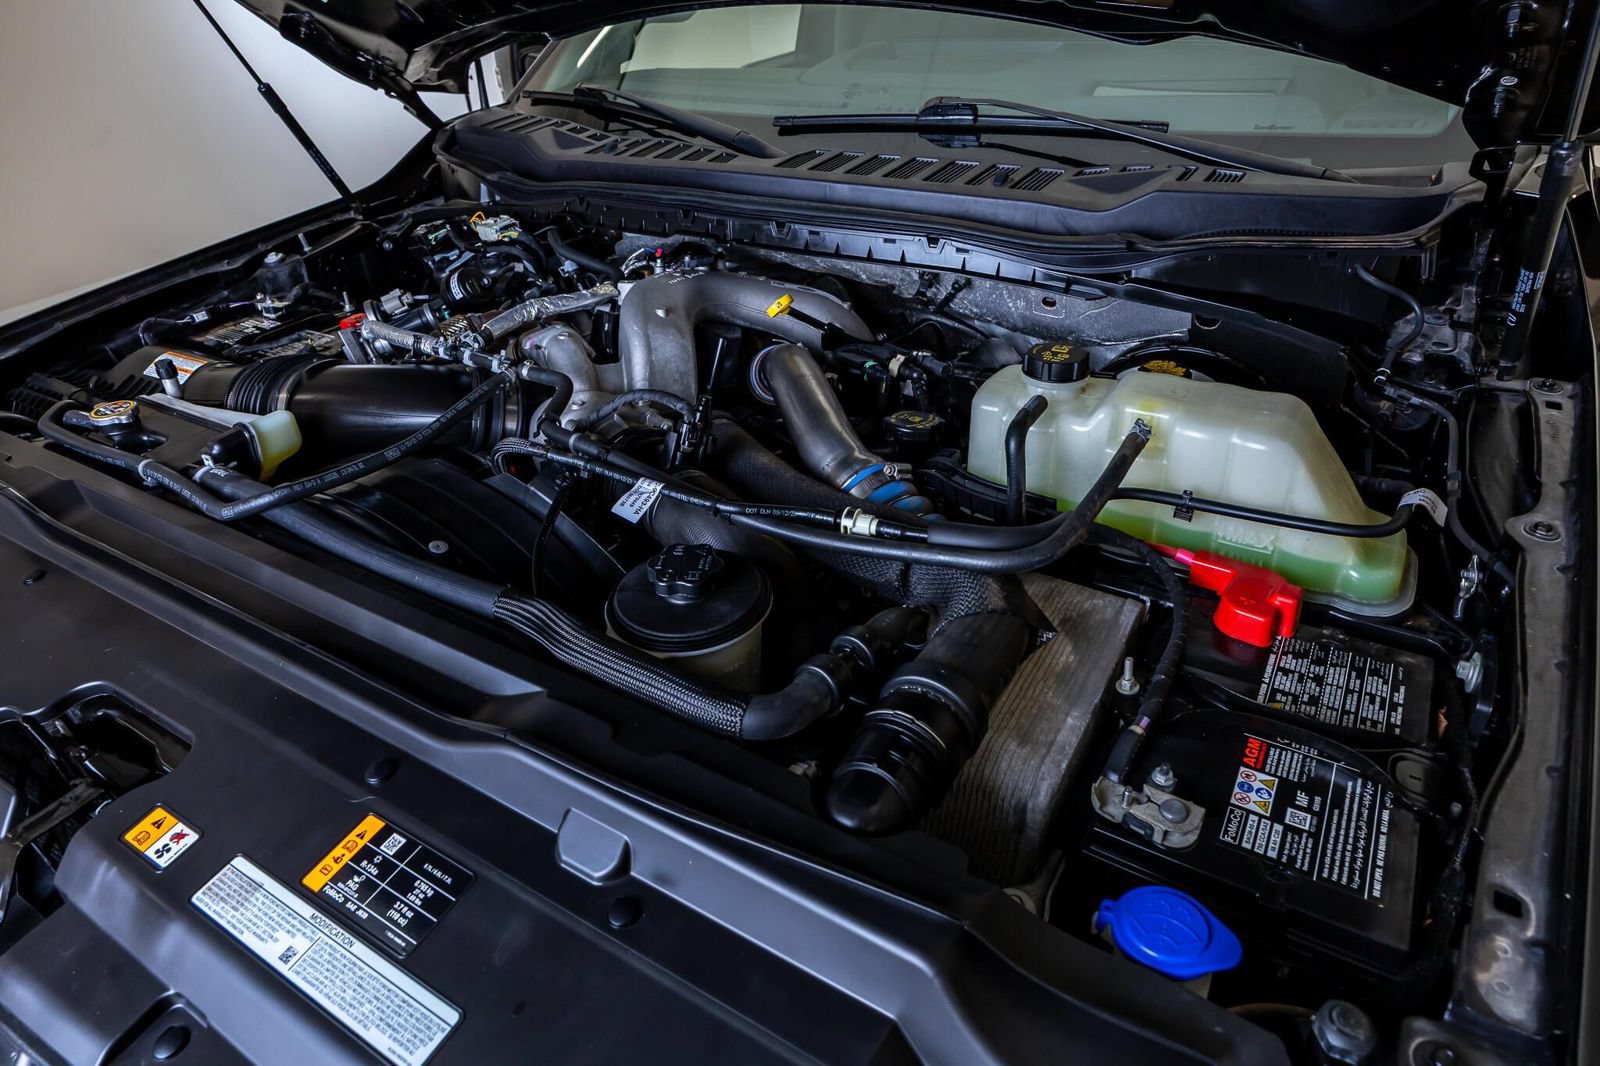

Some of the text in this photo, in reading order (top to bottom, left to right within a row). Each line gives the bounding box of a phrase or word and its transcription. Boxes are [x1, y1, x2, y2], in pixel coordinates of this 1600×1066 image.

[1241, 737, 1261, 767] AGM
[1294, 789, 1310, 808] MF
[1223, 807, 1242, 842] FoMoCo
[360, 860, 379, 876] R-134a
[345, 880, 359, 891] PAG
[309, 912, 356, 949] MODIFICATION
